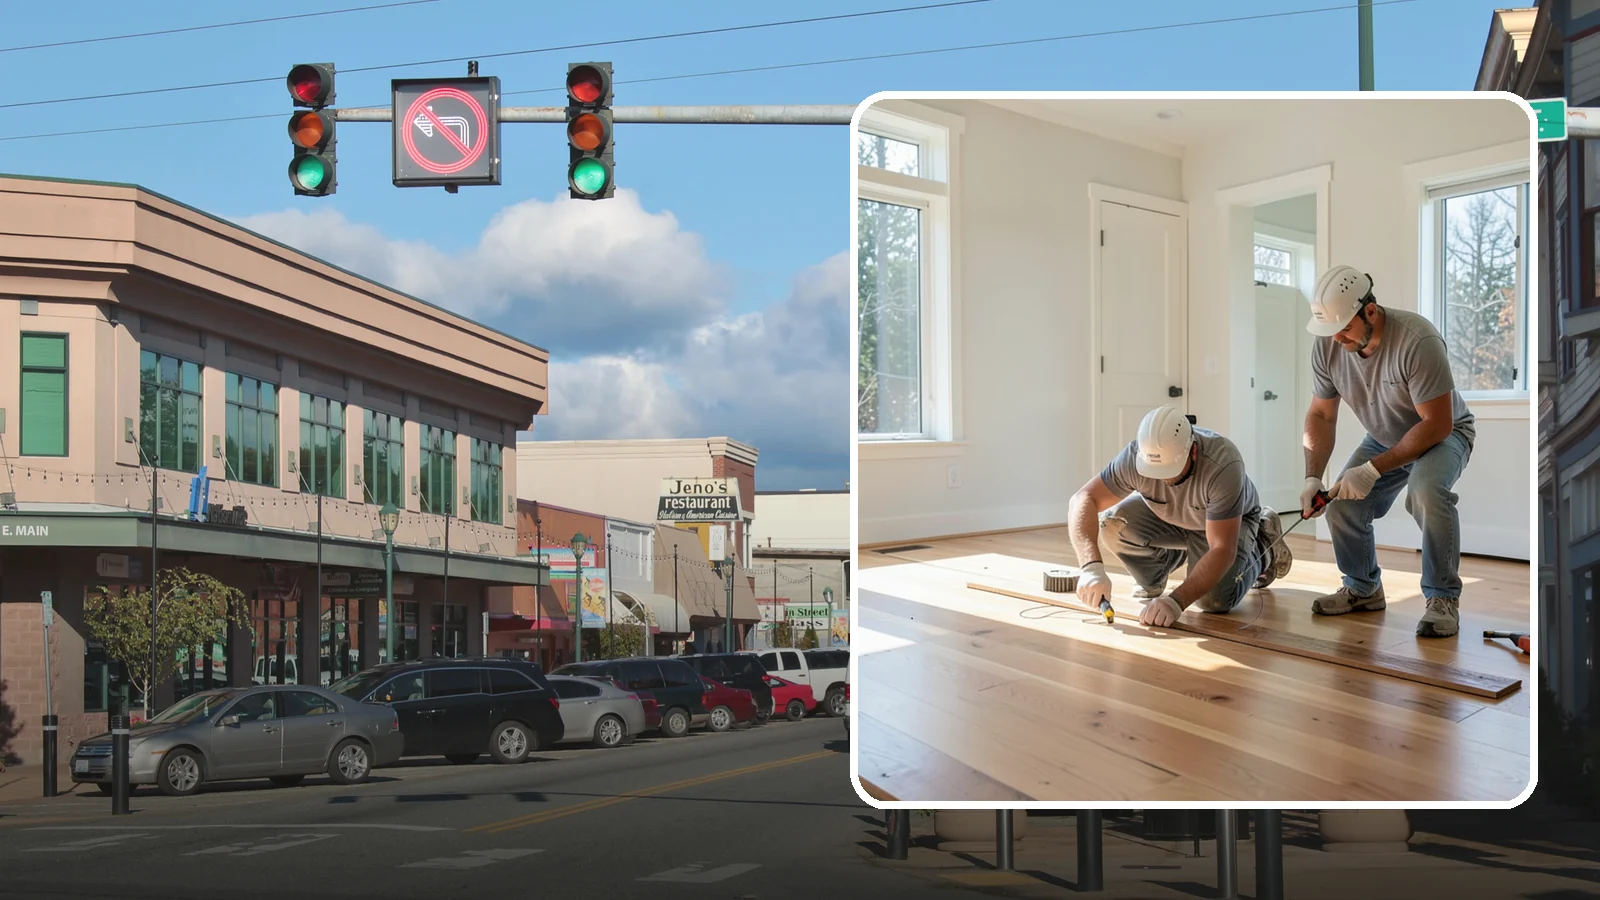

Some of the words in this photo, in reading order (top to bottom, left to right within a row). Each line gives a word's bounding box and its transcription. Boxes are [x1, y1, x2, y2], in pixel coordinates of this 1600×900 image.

[670, 480, 727, 494] Jeno's
[665, 497, 731, 509] restaurant
[659, 510, 681, 519] Italian
[686, 510, 714, 519] American
[715, 509, 737, 519] Cuisine
[2, 525, 13, 536] E.
[16, 525, 49, 536] MAIN
[797, 608, 828, 616] Street
